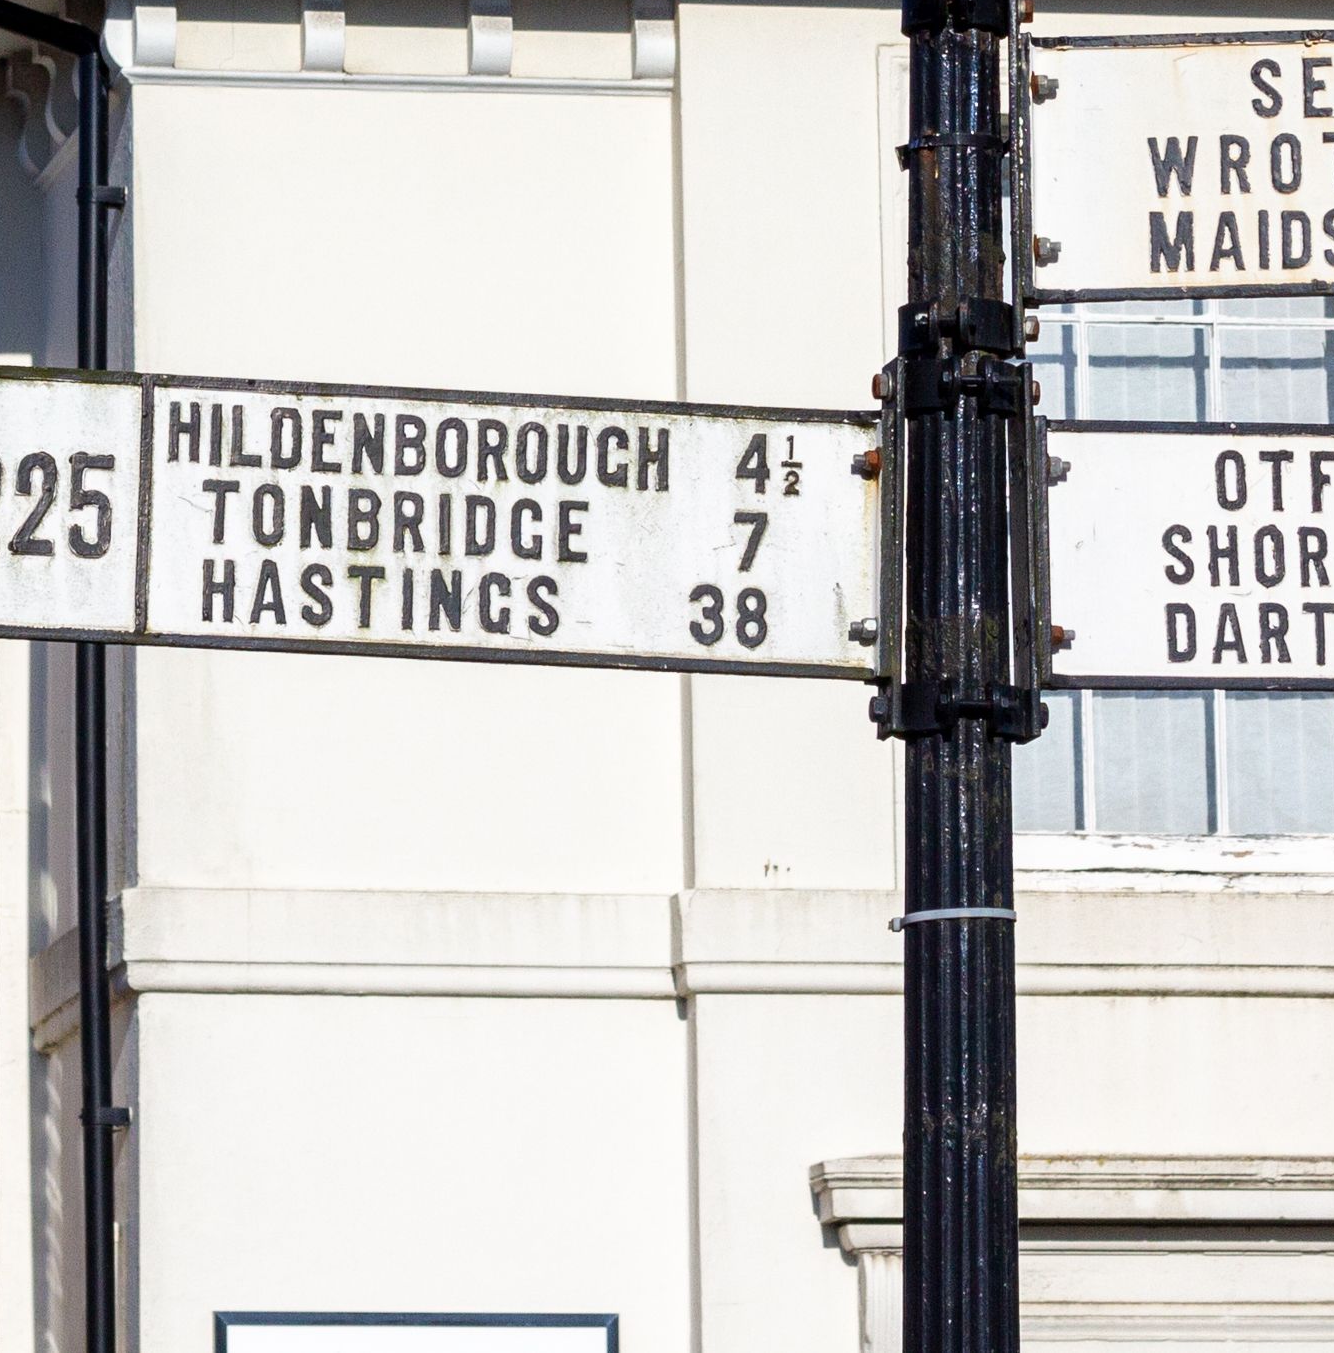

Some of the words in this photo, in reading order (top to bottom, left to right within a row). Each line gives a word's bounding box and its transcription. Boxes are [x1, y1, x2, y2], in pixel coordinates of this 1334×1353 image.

[167, 399, 672, 494] HILDENBOROUGH
[202, 476, 589, 565] TONBRIDGE
[733, 511, 768, 572] 7
[202, 559, 560, 637] HASTINGS
[689, 583, 768, 649] 38
